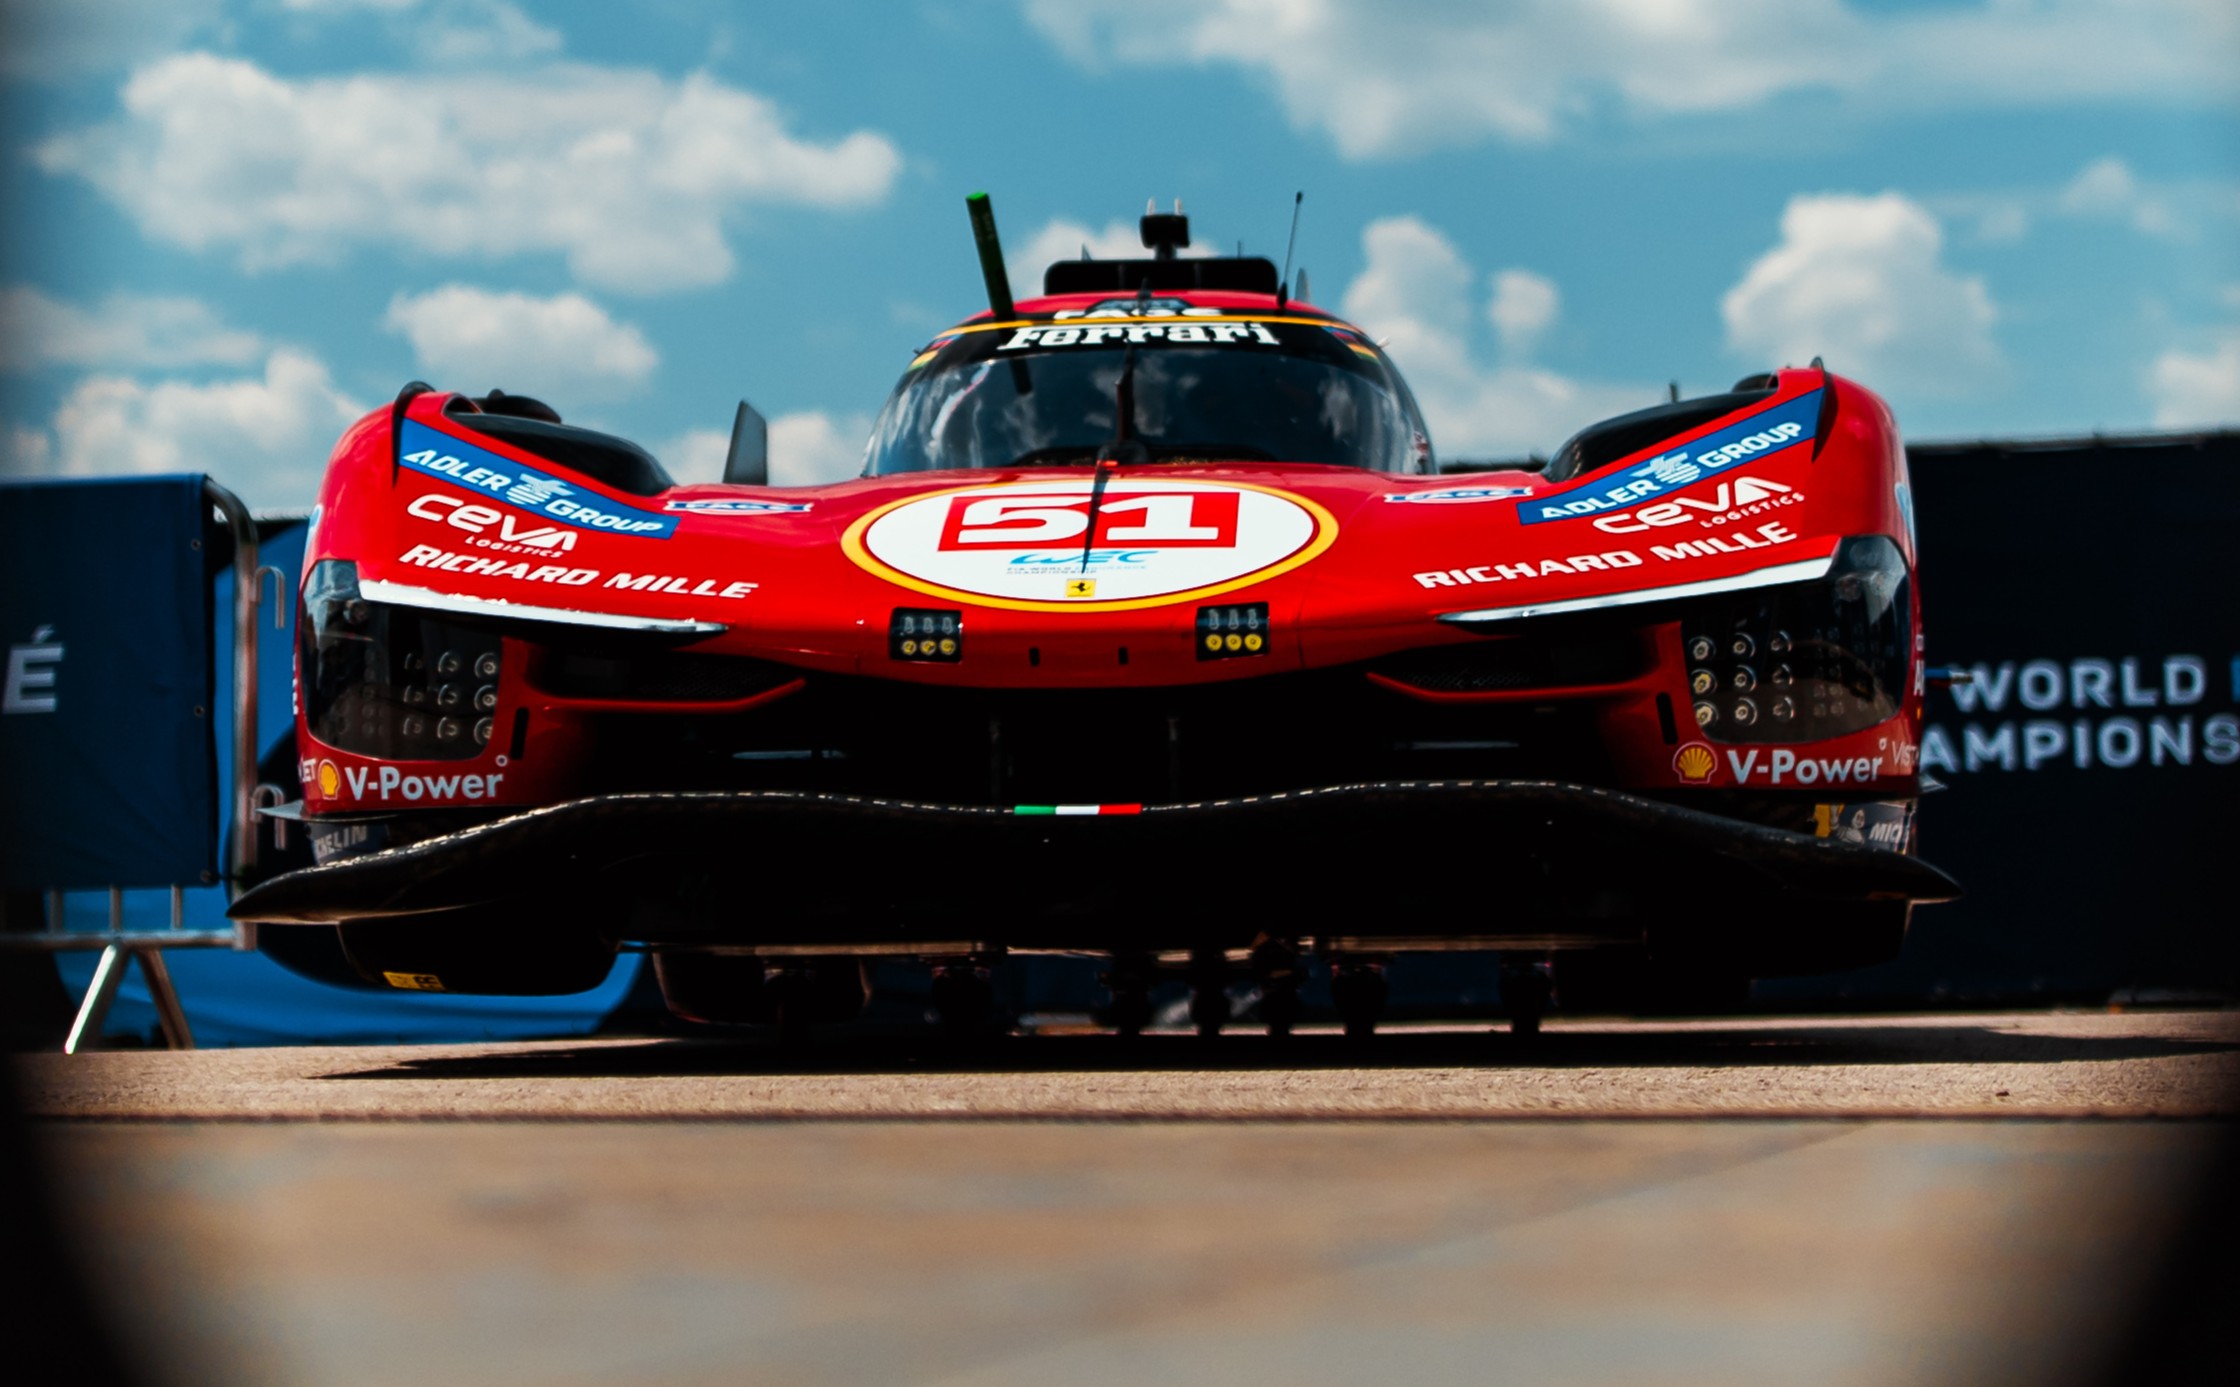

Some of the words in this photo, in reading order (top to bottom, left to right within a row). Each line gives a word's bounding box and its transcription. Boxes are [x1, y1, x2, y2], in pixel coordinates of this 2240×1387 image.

[997, 321, 1281, 351] Ferrari
[402, 449, 513, 491] ADLER
[544, 500, 664, 534] GROUP
[1540, 478, 1661, 520] ADLER
[1697, 421, 1802, 469] GROUP
[957, 493, 1219, 545] 51
[1700, 492, 1805, 528] LOGISTICS
[465, 535, 564, 559] LOGISTICS
[1010, 550, 1159, 565] WEC
[1413, 549, 1643, 589] RICHARD
[1649, 521, 1797, 562] MILLE
[400, 544, 600, 586] RICHARD
[603, 572, 759, 598] MILLE
[1947, 655, 2206, 713] WORLD
[345, 766, 504, 801] V-Power
[1727, 749, 1883, 784] V-Power
